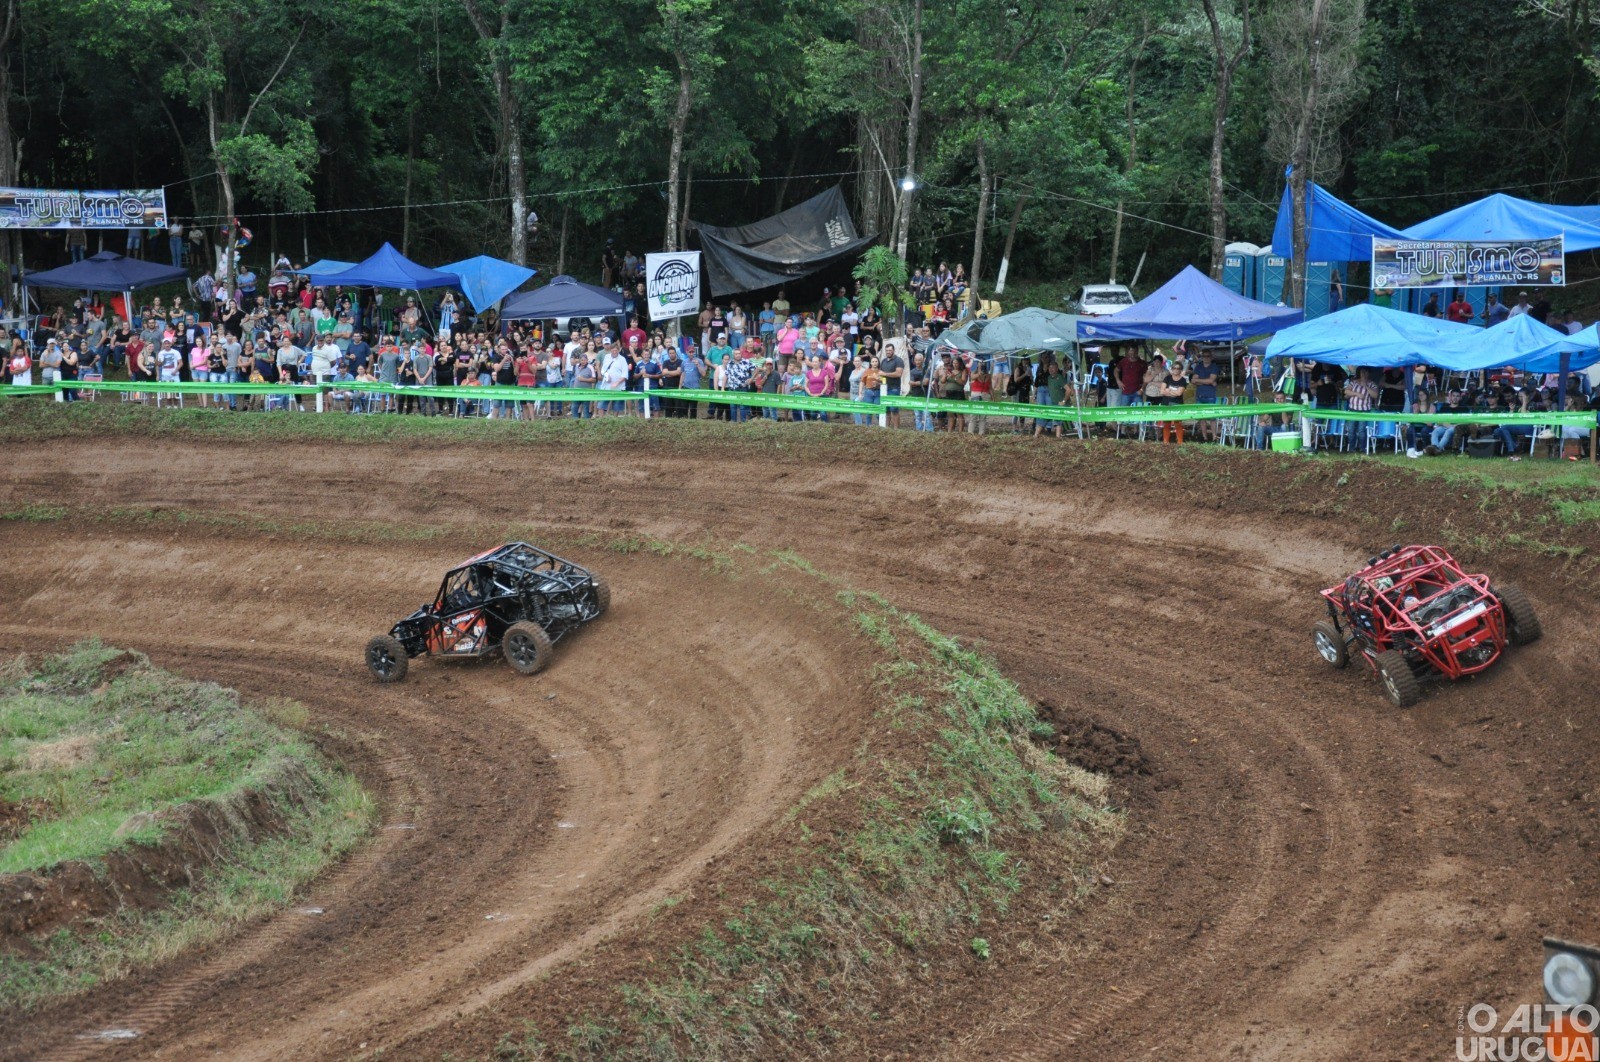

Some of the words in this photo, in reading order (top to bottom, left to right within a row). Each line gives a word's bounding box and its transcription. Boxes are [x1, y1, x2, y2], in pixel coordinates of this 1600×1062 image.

[15, 197, 145, 218] TURISMO
[1397, 241, 1441, 250] Secretaria
[1396, 247, 1541, 275] TURISMO
[1478, 273, 1539, 281] PLANALTO-RS
